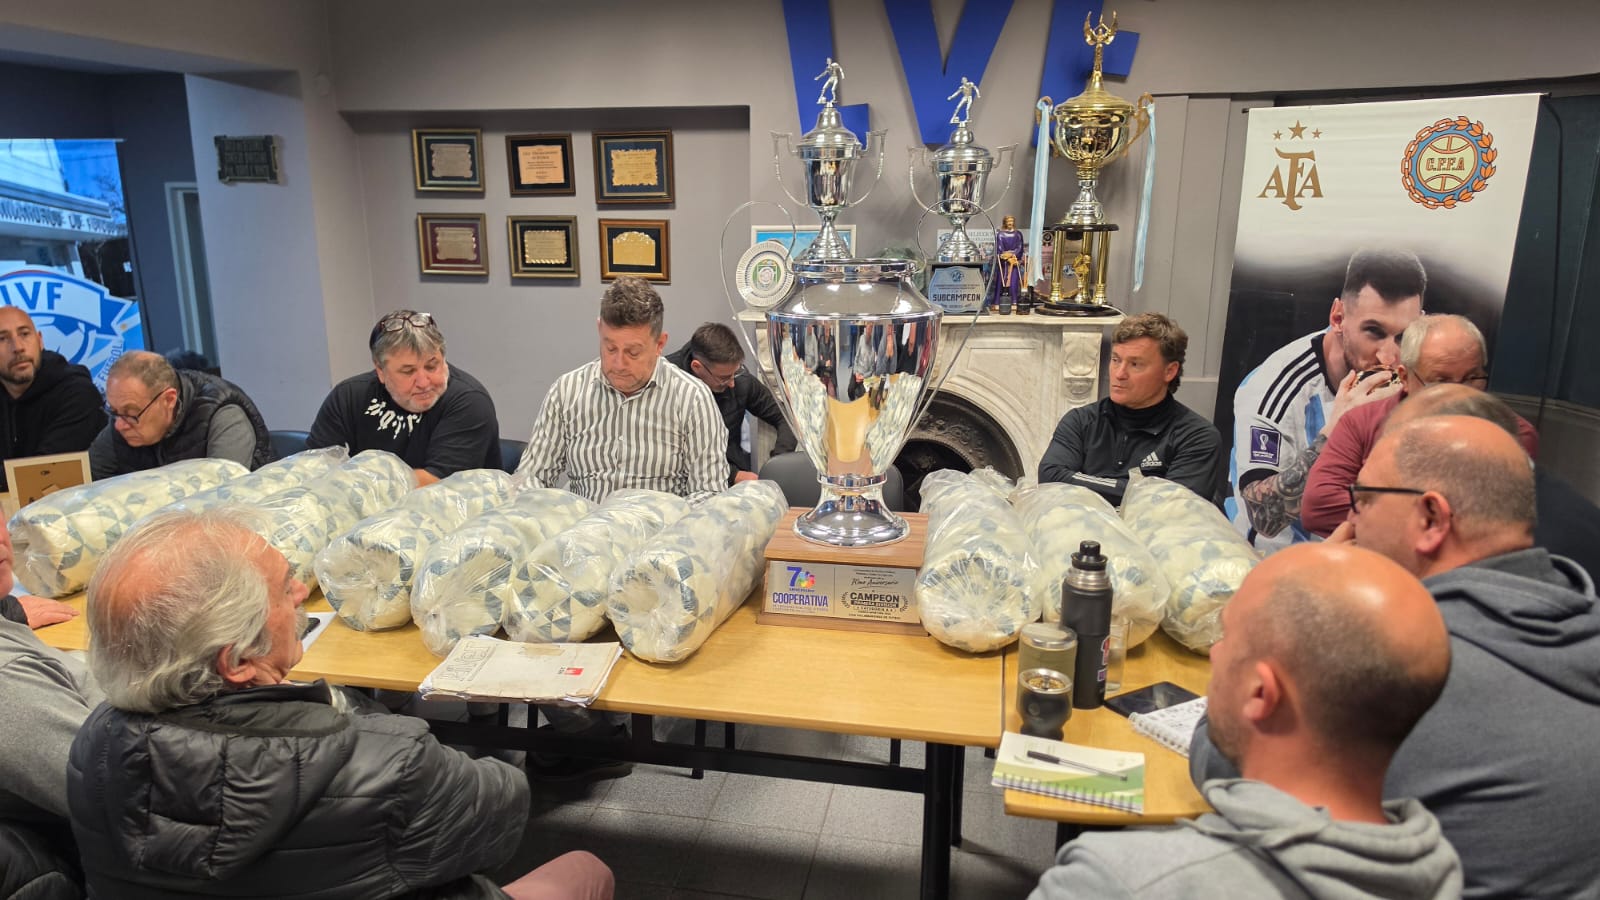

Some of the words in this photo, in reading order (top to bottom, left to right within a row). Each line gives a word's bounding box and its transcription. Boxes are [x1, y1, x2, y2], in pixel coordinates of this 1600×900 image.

[1257, 147, 1324, 211] AFA
[1140, 460, 1163, 468] adidas
[772, 592, 829, 607] COOPERATIVA
[850, 591, 900, 603] CAMPEON
